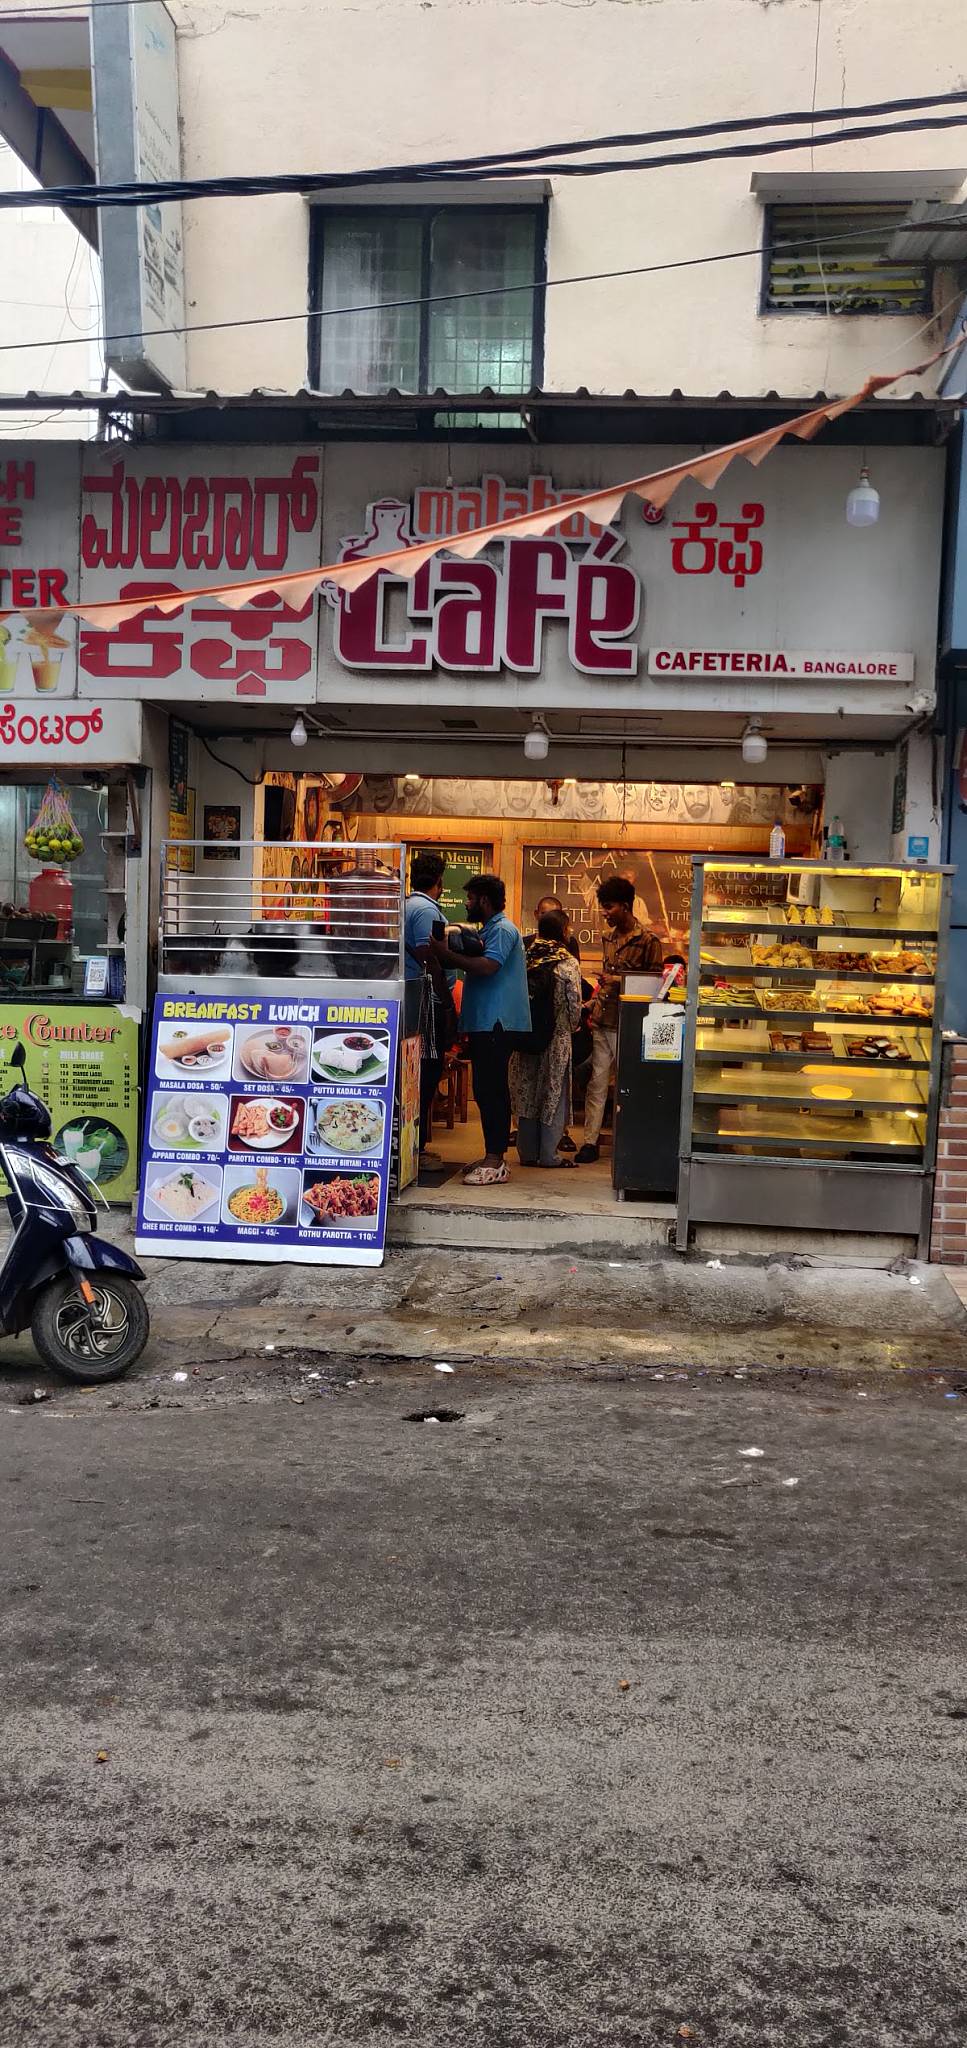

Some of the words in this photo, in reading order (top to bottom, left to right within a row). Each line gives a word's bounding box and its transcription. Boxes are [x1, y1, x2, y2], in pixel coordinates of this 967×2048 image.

[81, 455, 320, 571] ಮಲಬಾರ್
[417, 479, 604, 538] malaba
[670, 502, 765, 588] ಕೆಫೆ
[655, 651, 796, 672] CAFETERIA.
[803, 661, 898, 676] BANGALORE
[529, 850, 617, 868] KERALA
[546, 873, 602, 894] TEA
[578, 929, 599, 943] OF
[164, 1002, 262, 1020] BREAKFAST
[269, 1005, 319, 1022] LUNCH
[327, 1007, 388, 1024] DINNER
[23, 1013, 121, 1047] Counter
[160, 1081, 185, 1089] MASALA
[187, 1082, 204, 1090] DOSA
[336, 1088, 361, 1096] KADALA
[304, 1158, 338, 1166] THALASSERY
[174, 1224, 197, 1232] COMBO
[237, 1227, 259, 1235] MAGGI
[299, 1230, 321, 1238] KOTHU
[322, 1231, 352, 1239] PAROTTA
